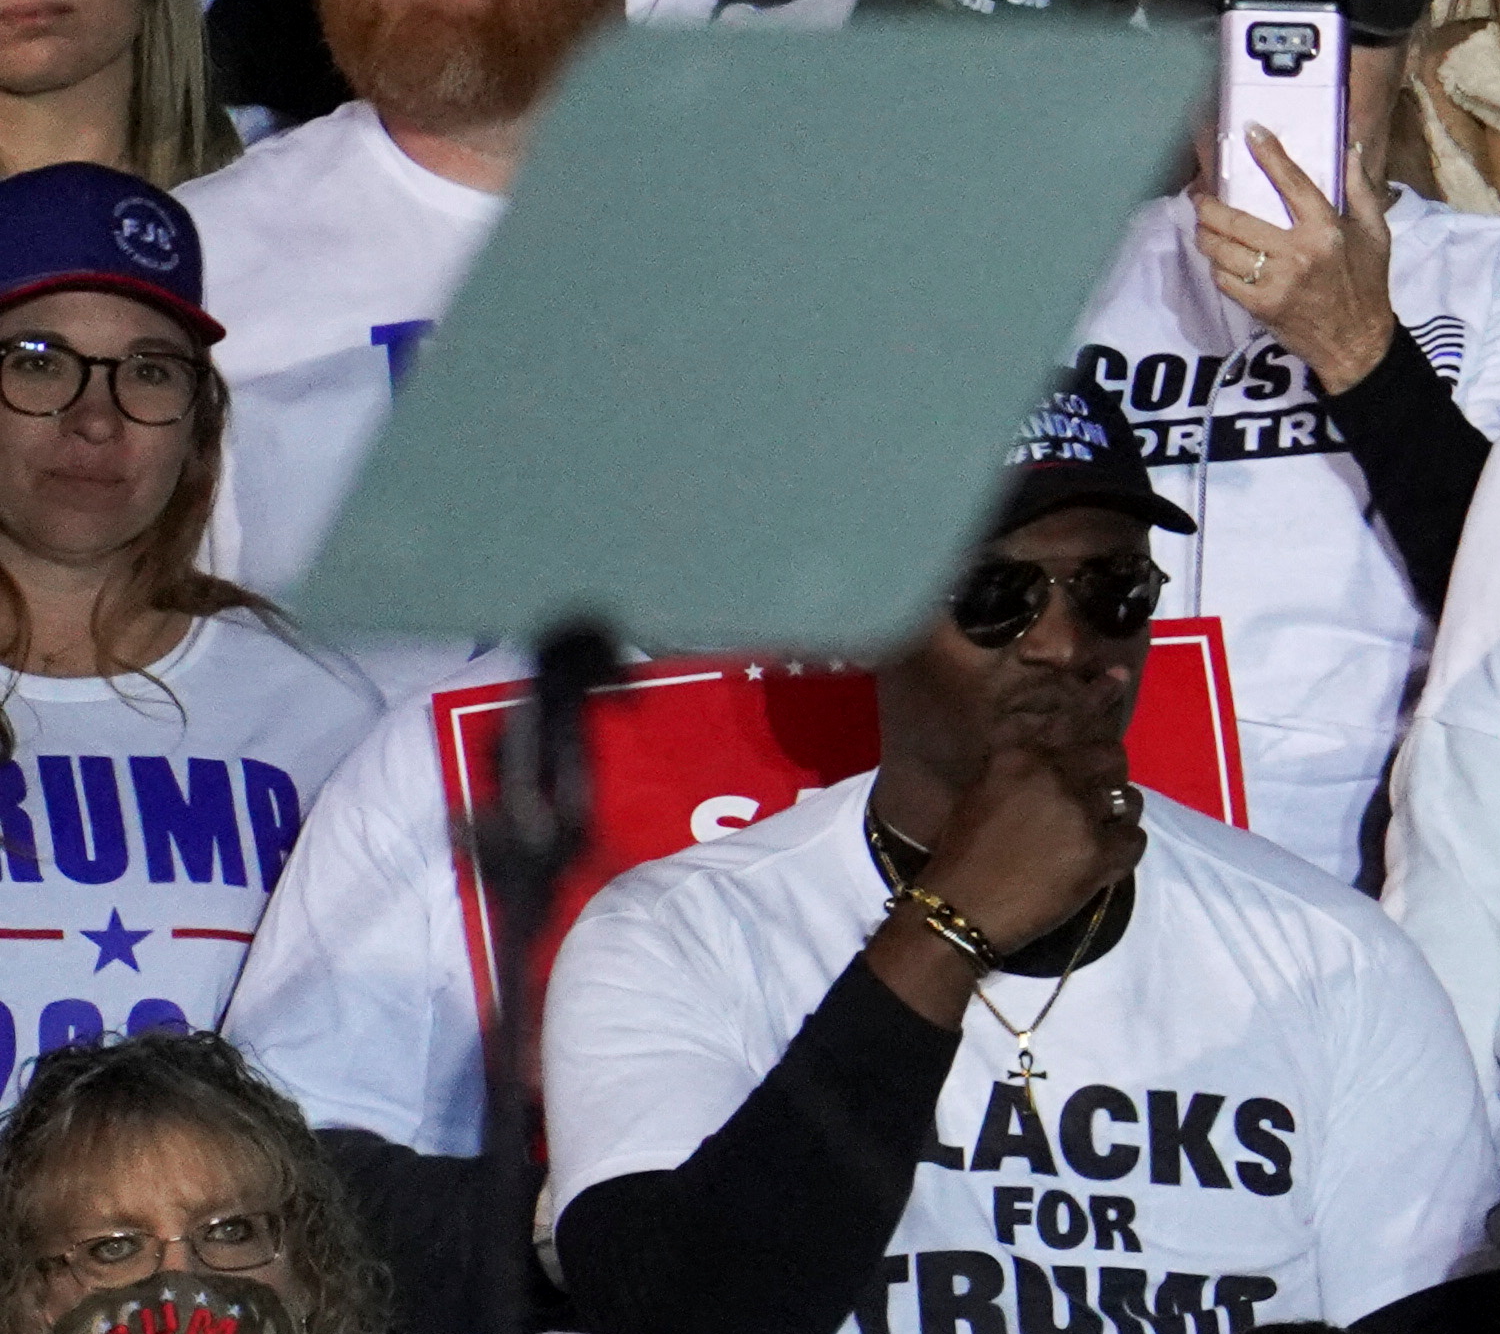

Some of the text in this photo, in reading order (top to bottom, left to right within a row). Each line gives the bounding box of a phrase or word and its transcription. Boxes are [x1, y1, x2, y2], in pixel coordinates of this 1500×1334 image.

[0, 755, 303, 892] RUMP
[938, 1085, 1296, 1198] ACKS
[992, 1186, 1141, 1253] FOR
